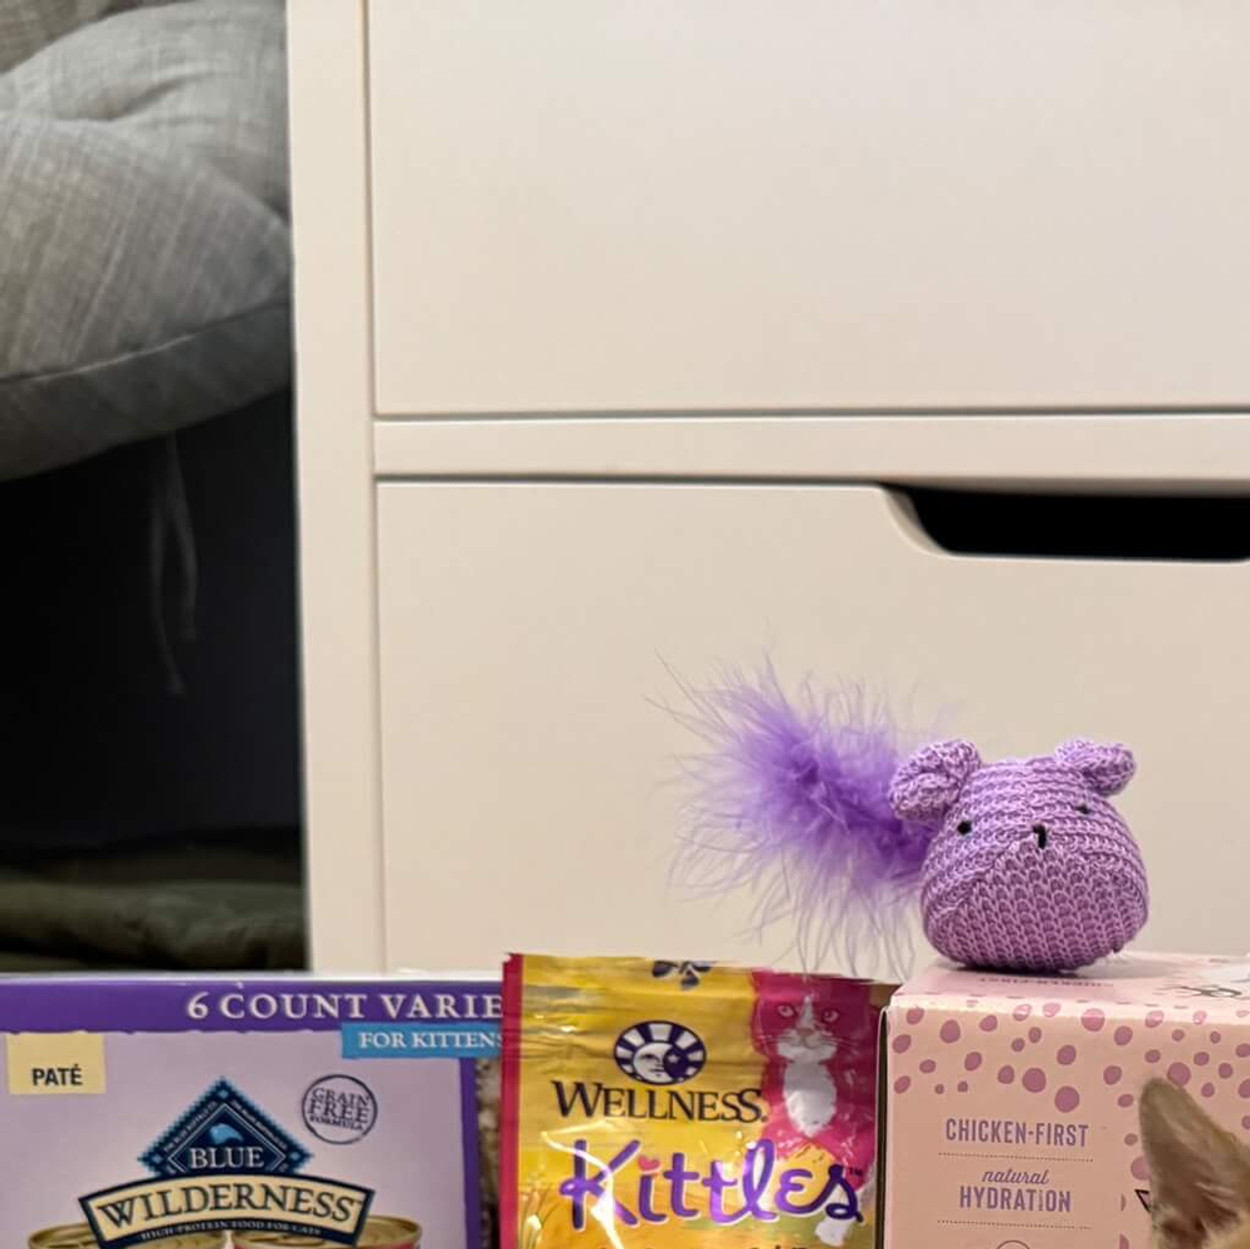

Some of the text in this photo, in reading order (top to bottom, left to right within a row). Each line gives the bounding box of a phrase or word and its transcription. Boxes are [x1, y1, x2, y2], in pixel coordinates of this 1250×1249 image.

[188, 991, 503, 1019] 6 COUNT VARIE
[360, 1032, 407, 1049] FOR
[31, 1062, 83, 1087] PATÉ
[312, 1087, 371, 1106] GRAIN
[551, 1080, 763, 1124] WELLNESS
[308, 1098, 370, 1124] FREE
[946, 1118, 1089, 1148] CHICKEN-FIRST
[190, 1146, 265, 1170] BLUE
[559, 1138, 864, 1232] Kittles
[982, 1168, 1050, 1187] natural
[97, 1182, 354, 1230] WILDERNESS
[959, 1186, 1071, 1213] HYDRATION
